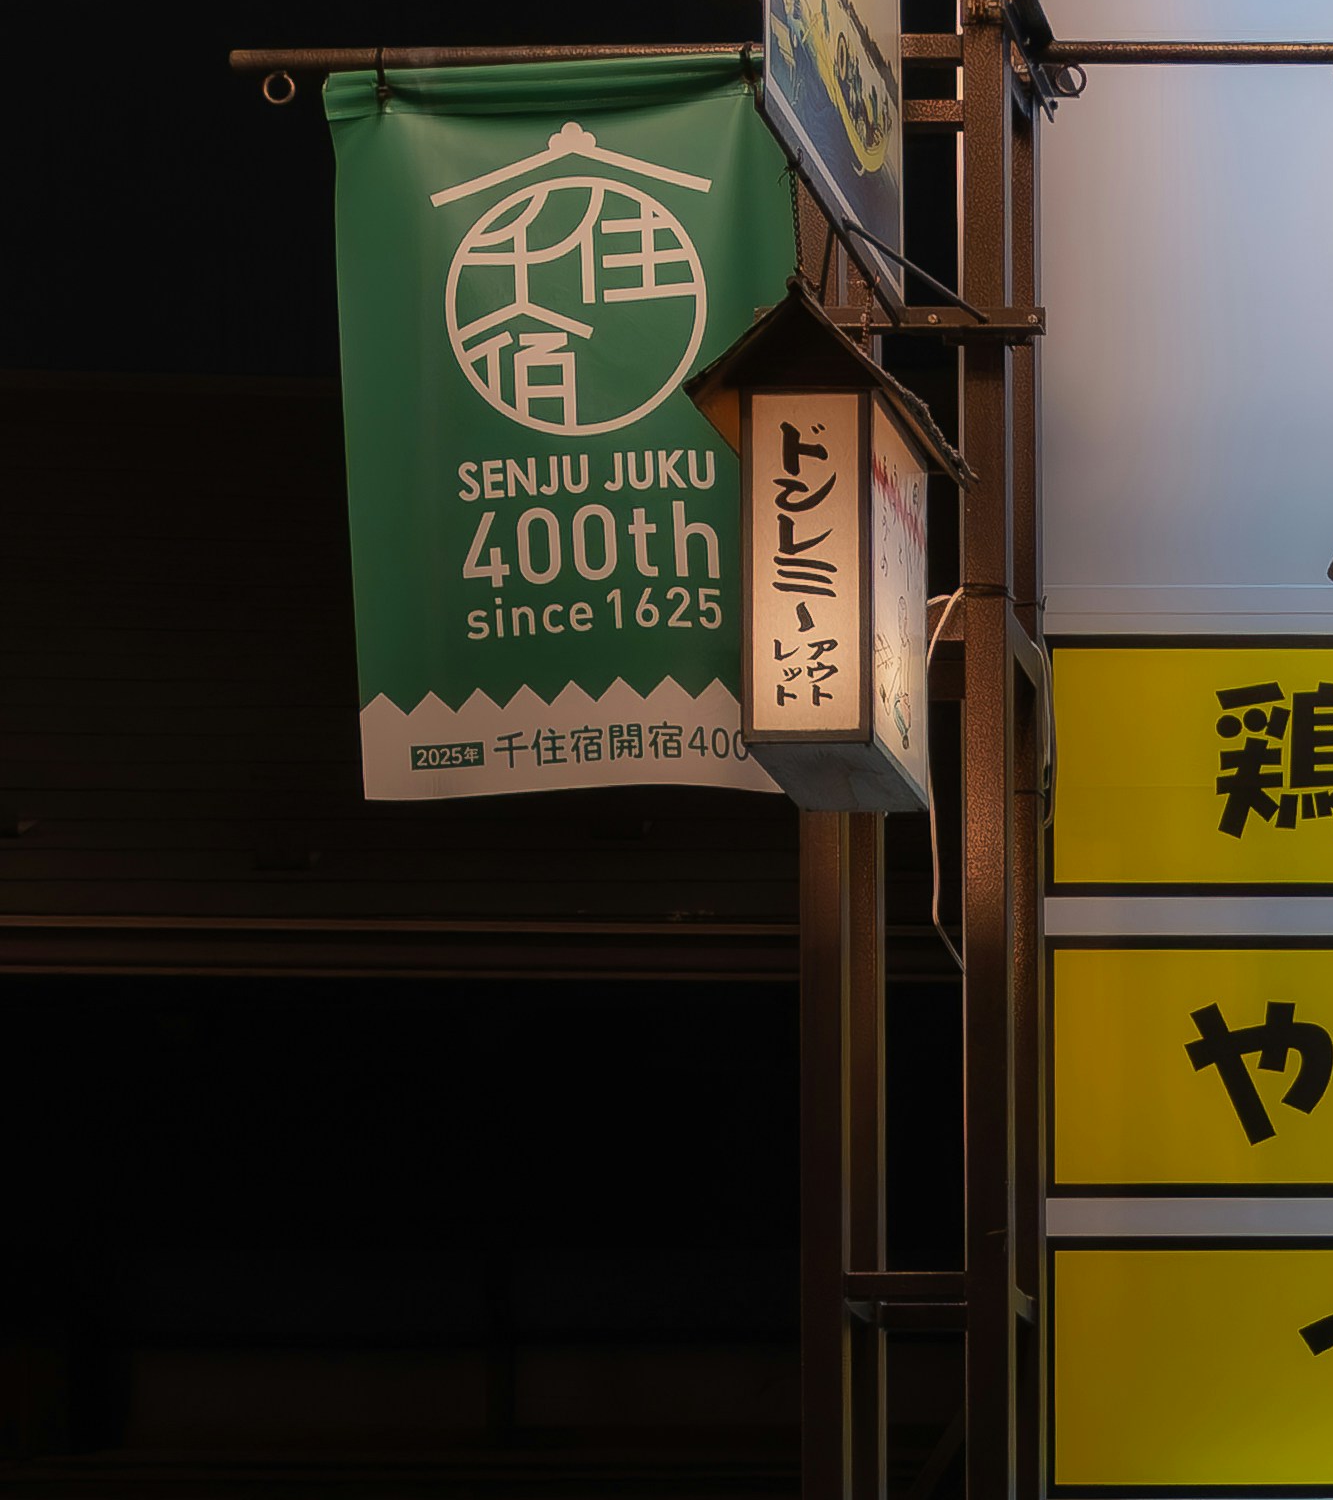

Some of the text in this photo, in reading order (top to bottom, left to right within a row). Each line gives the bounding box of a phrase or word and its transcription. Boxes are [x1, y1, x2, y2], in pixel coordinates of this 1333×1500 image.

[458, 449, 716, 502] SENJU JUKU
[462, 500, 720, 588] 400th
[772, 421, 837, 632] ドンレミー
[467, 587, 723, 640] since 1625
[774, 638, 802, 706] レット
[807, 638, 838, 706] アウト
[415, 745, 480, 768] 2025年
